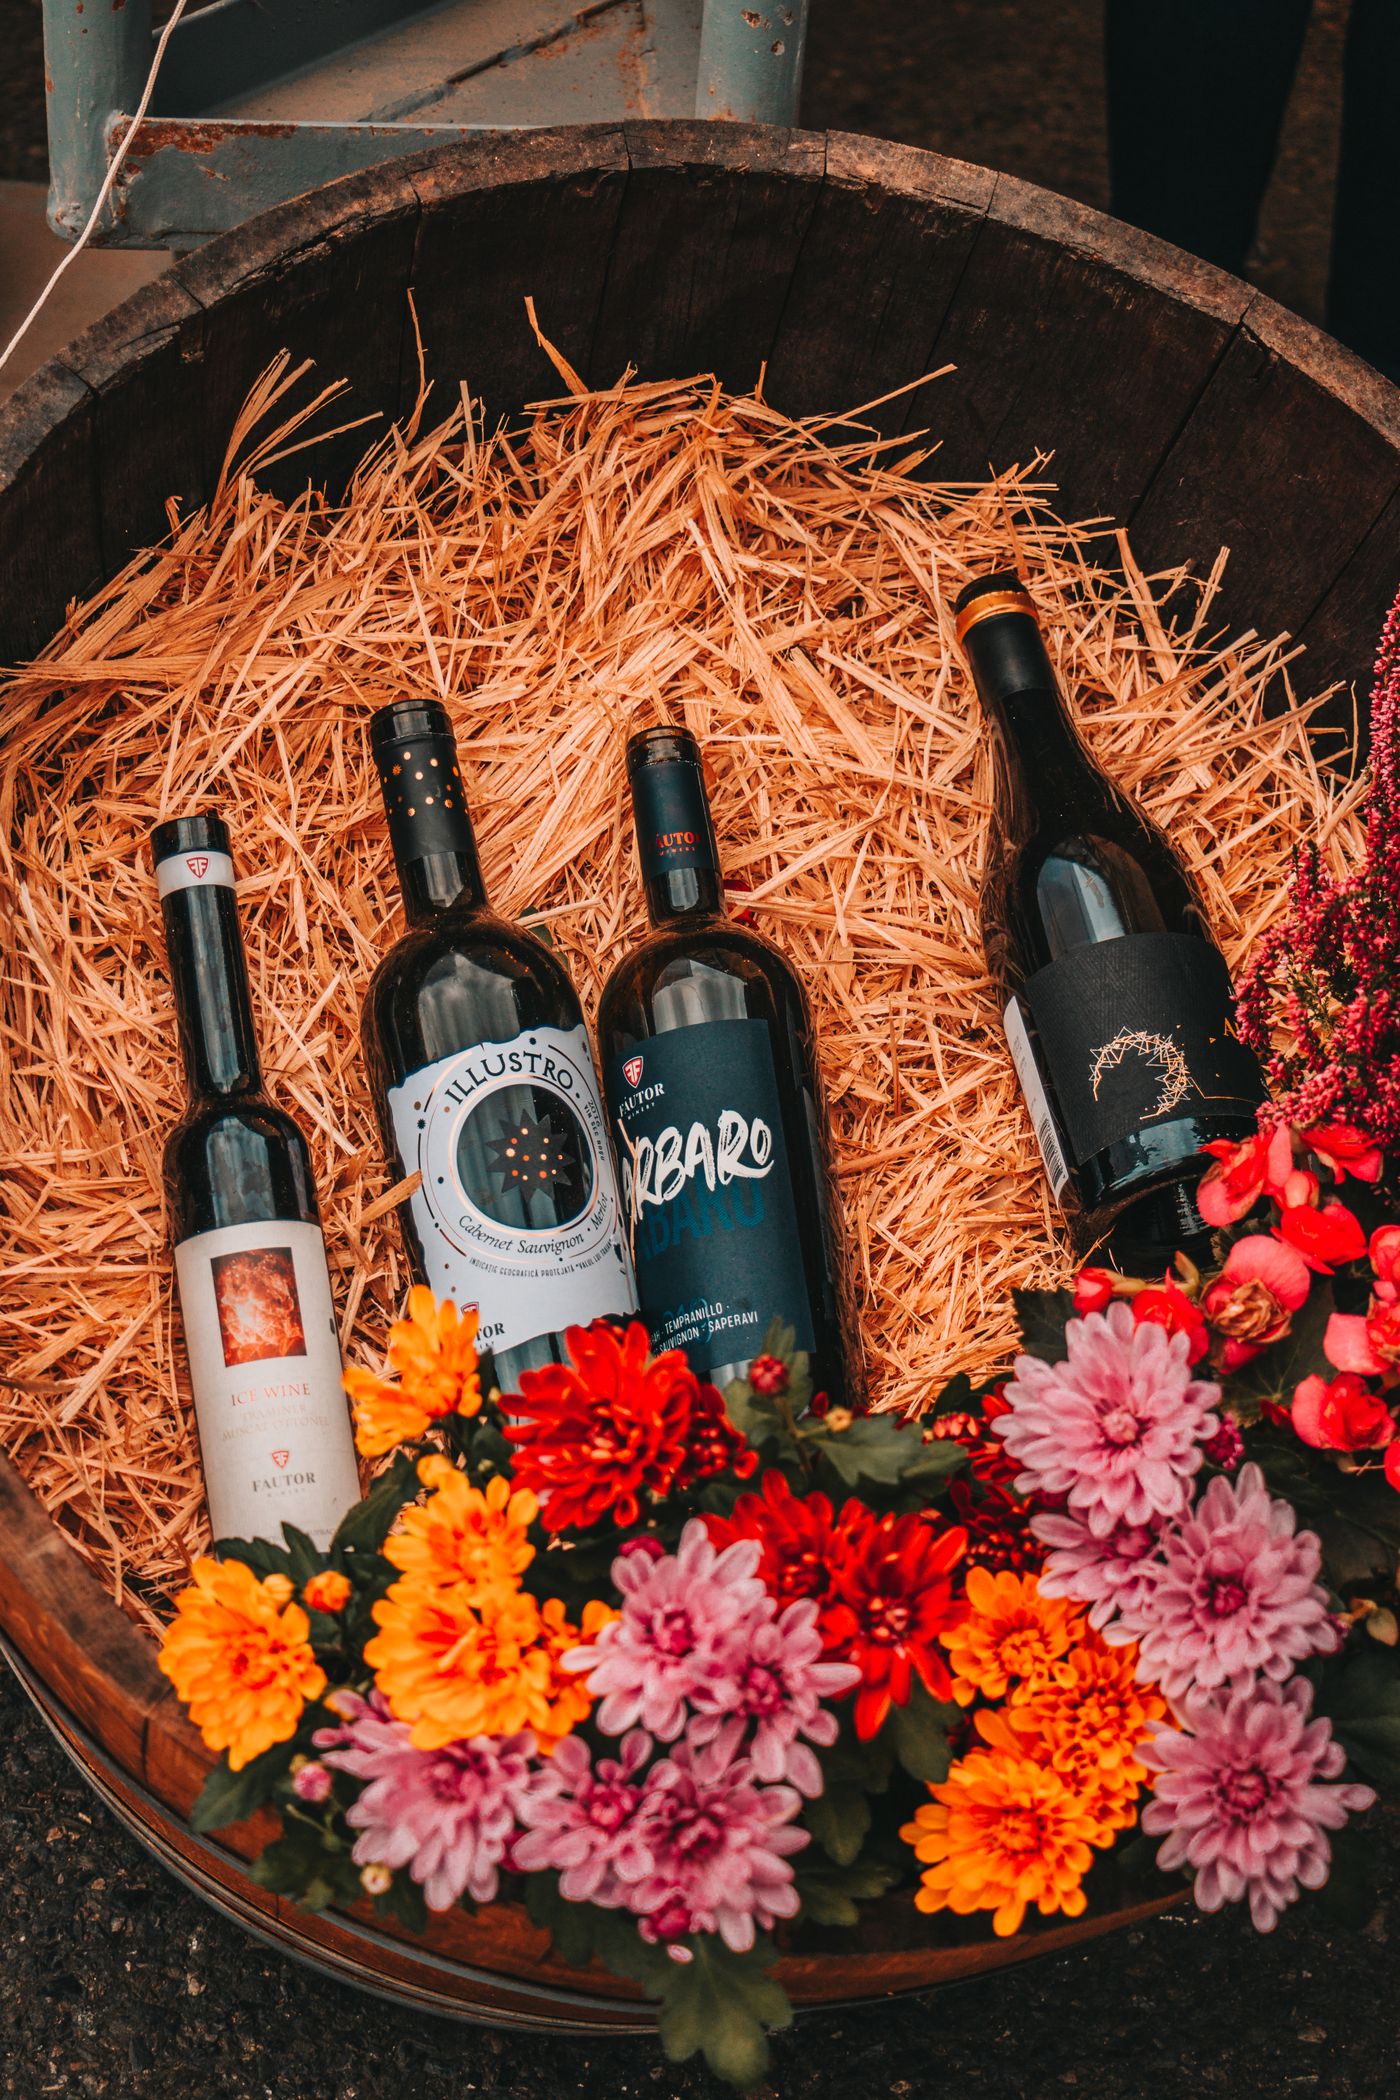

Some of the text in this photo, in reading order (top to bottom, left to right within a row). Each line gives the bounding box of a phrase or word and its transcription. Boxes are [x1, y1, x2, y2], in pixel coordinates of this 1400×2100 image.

[656, 831, 699, 848] AUTO
[444, 1051, 574, 1104] ILLUSTRO
[459, 1192, 608, 1255] Cabernet Sauvignon Merlot
[476, 1322, 505, 1341] TOR
[659, 1326, 699, 1353] SAUVIGNON
[707, 1310, 758, 1333] SAPERAVI
[665, 1302, 723, 1335] TEMPRANILLO
[231, 1383, 311, 1407] ICE WINE
[252, 1472, 316, 1492] FAUTOR
